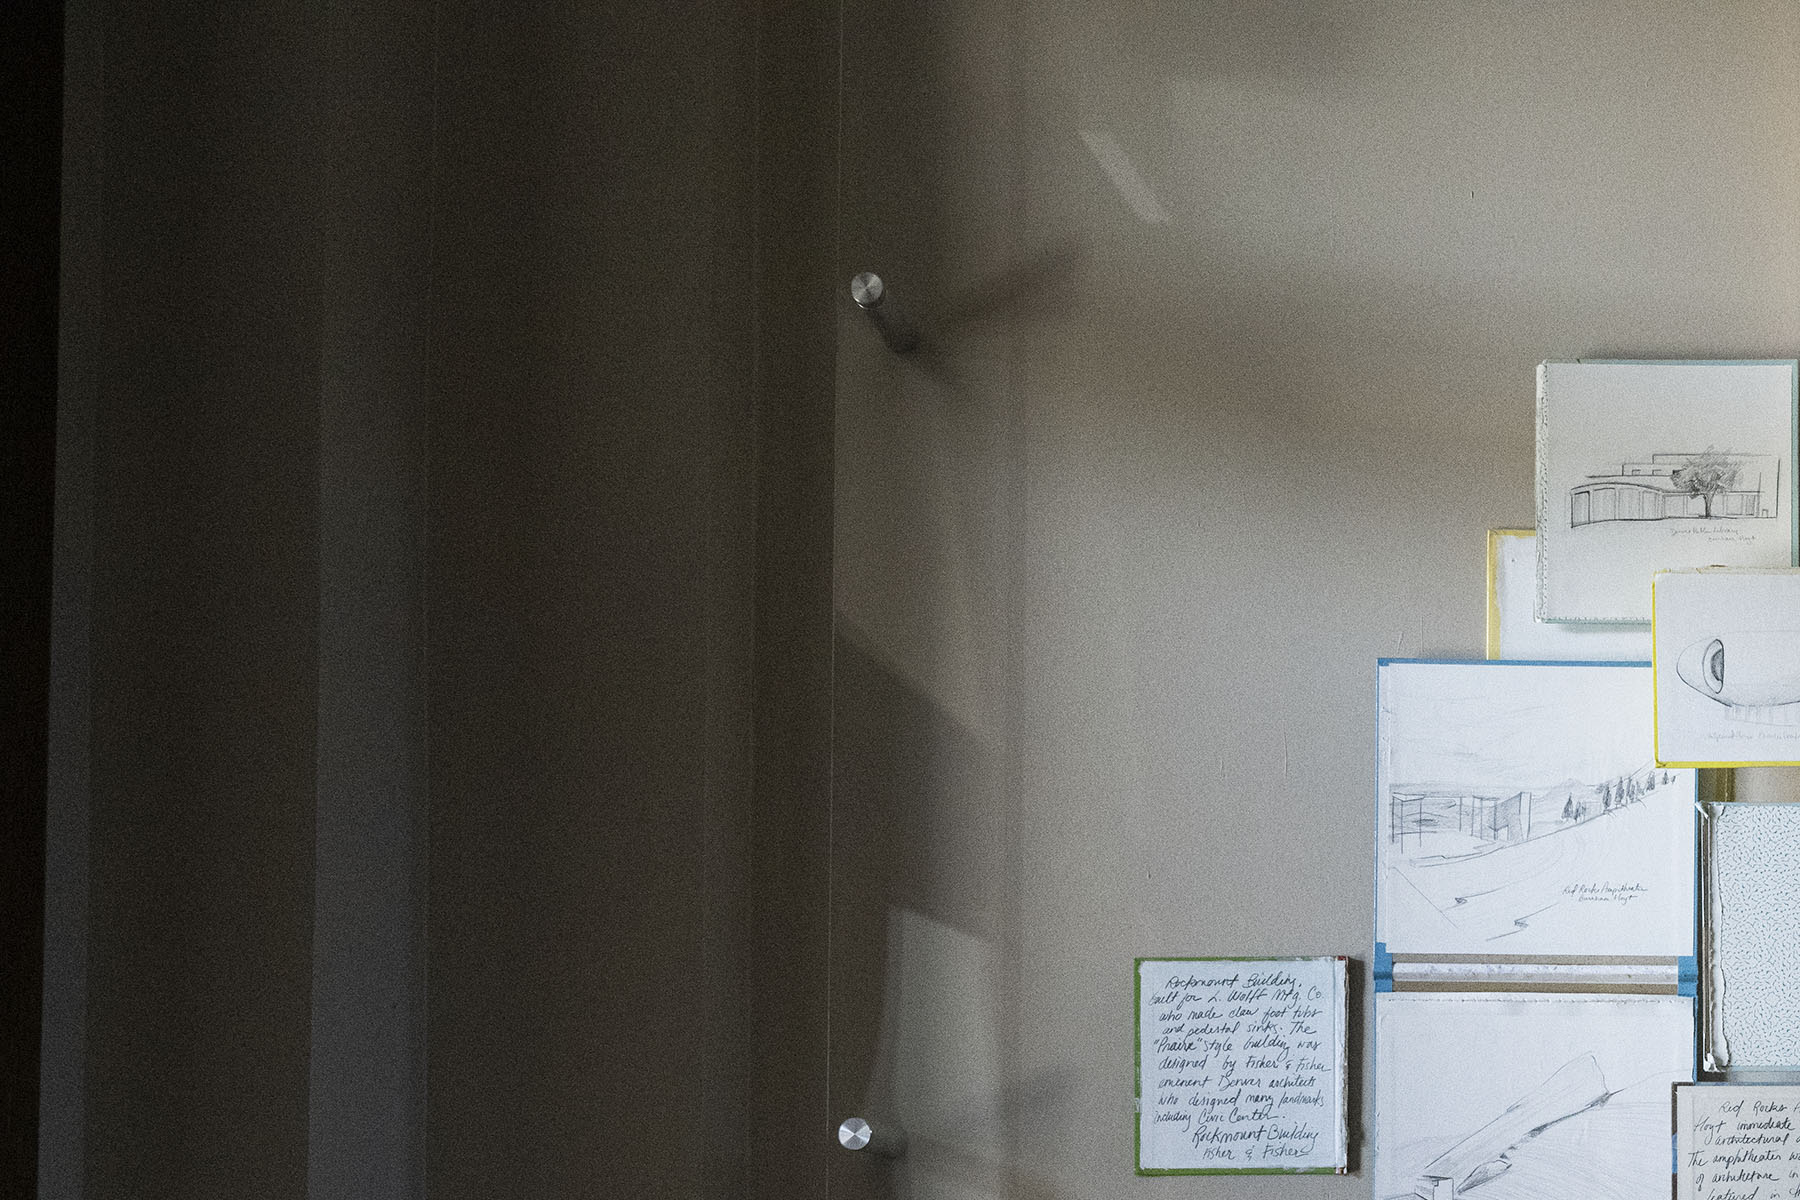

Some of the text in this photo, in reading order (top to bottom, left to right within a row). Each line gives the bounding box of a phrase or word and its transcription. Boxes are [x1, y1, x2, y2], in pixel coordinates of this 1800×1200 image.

[1159, 1007, 1223, 1022] who made
[1163, 1024, 1184, 1034] and
[1290, 1021, 1316, 1034] The
[1158, 1055, 1331, 1076] designed by Fisher Fisher
[1218, 1075, 1316, 1091] Denver architects
[1188, 1089, 1241, 1113] designed
[1720, 1100, 1788, 1114] Red Rocks
[1191, 1122, 1319, 1149] Rockmount Building
[1203, 1143, 1309, 1160] Fisher Fisher
